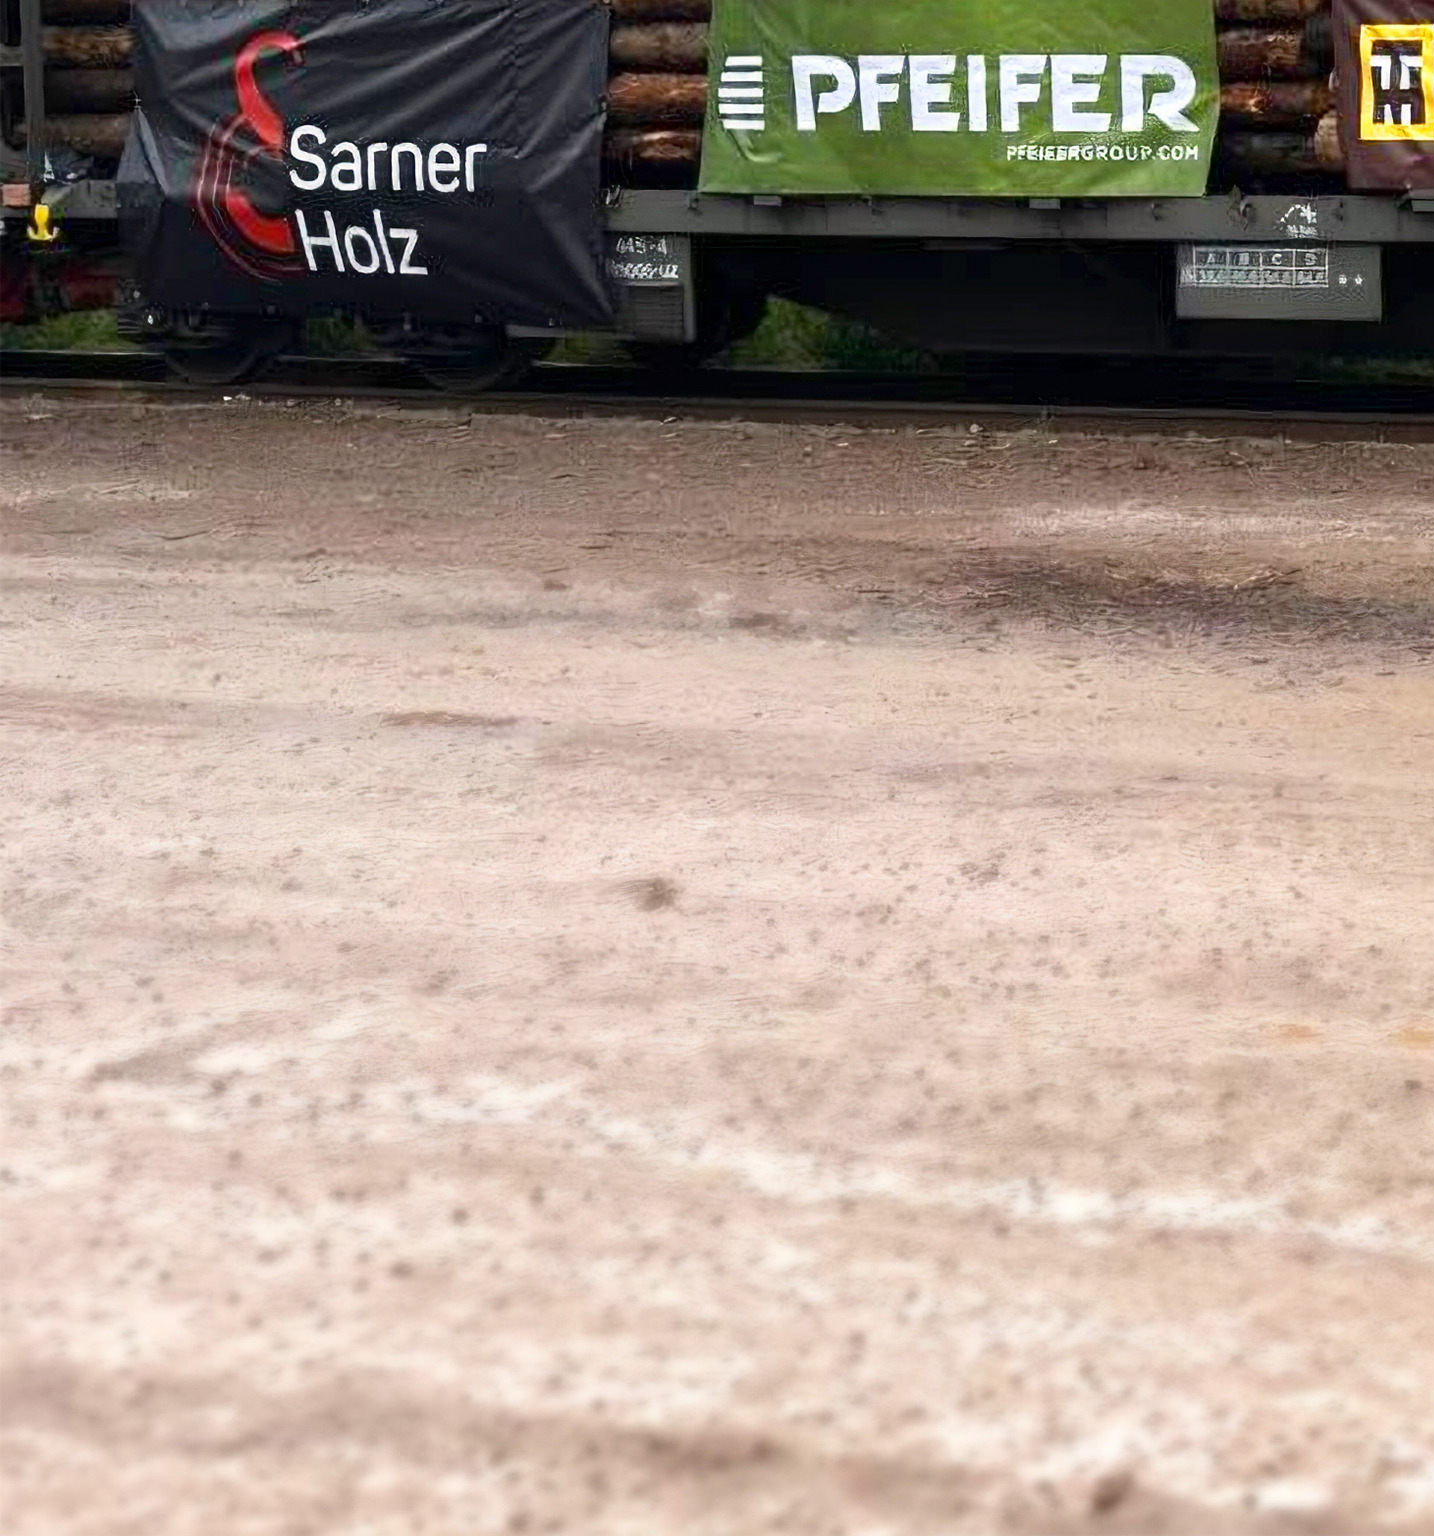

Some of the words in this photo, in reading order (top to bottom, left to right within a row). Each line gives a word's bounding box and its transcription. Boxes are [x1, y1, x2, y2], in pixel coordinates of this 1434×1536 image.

[791, 54, 1200, 133] PFEIFER
[289, 124, 488, 193] Sarner
[294, 208, 429, 276] Holz
